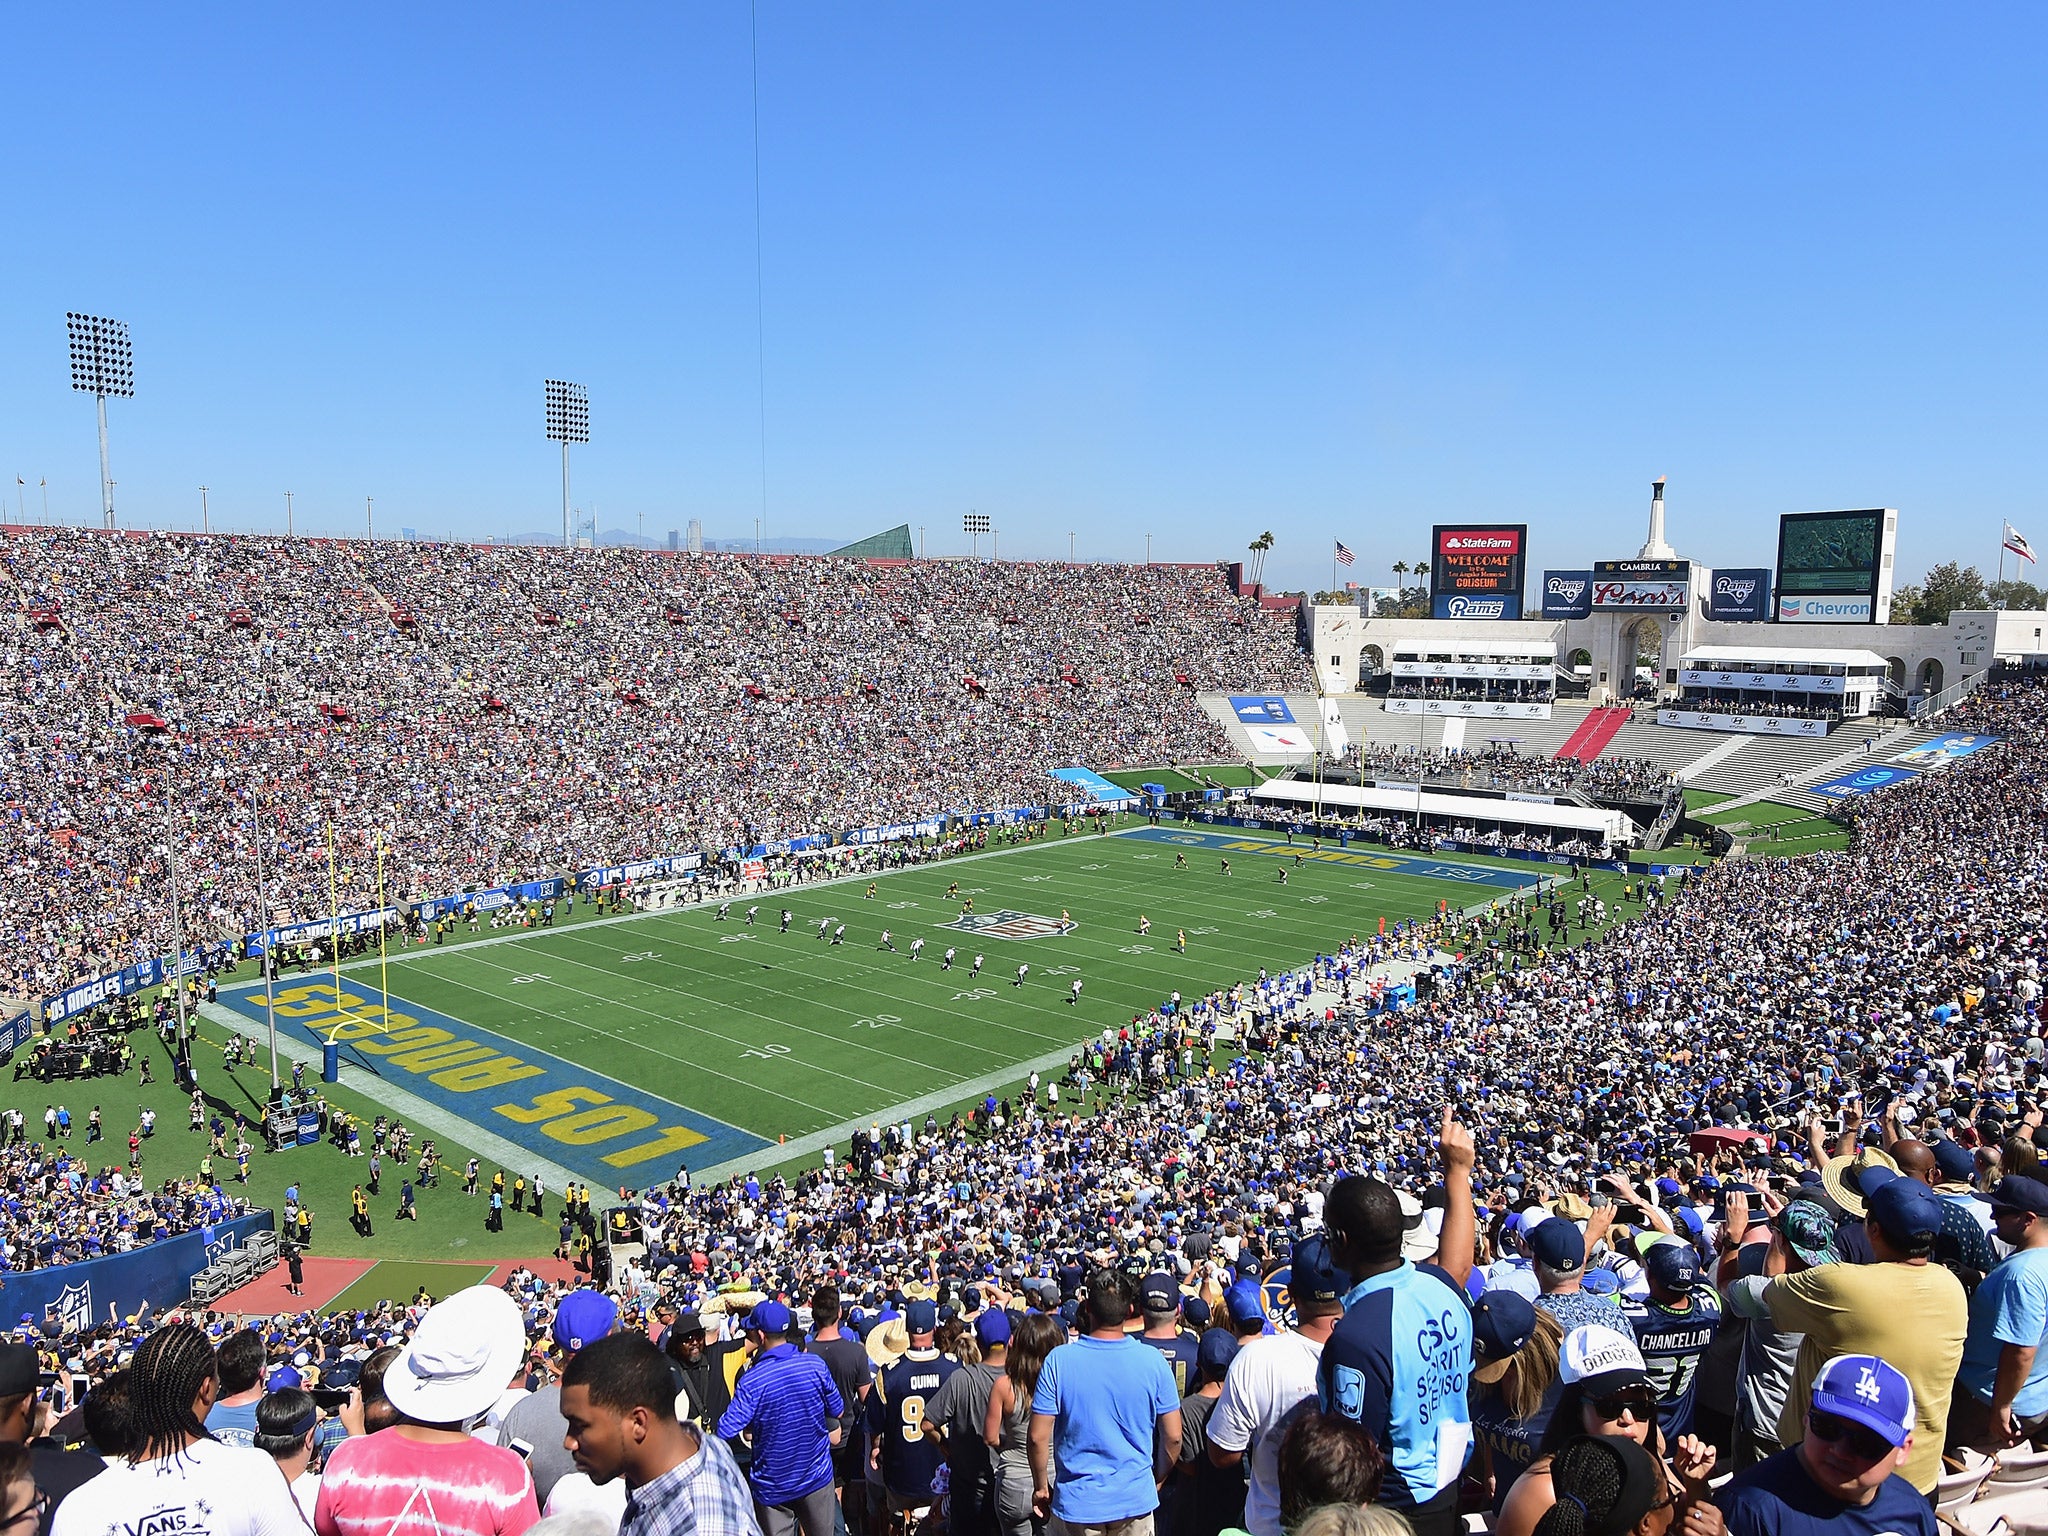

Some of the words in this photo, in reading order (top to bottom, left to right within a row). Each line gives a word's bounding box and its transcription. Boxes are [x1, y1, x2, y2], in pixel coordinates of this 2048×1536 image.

[1447, 556, 1510, 566] WELCOME
[1620, 563, 1661, 571] CAMBRIA
[1456, 578, 1497, 588] COLISEUM
[1548, 578, 1585, 594] Rams
[1594, 583, 1684, 604] Coors
[1448, 596, 1504, 619] Rams
[1806, 602, 1869, 615] Chevron
[862, 830, 877, 843] LOS
[1219, 841, 1410, 869] RAMS
[602, 870, 622, 884] LOS
[672, 856, 702, 872] RAMS
[473, 892, 505, 910] Rams
[274, 928, 298, 943] LOS
[512, 973, 551, 984] 10
[51, 1000, 64, 1020] OS
[68, 976, 120, 1014] ANGELES
[855, 1014, 901, 1028] 20
[245, 984, 548, 1092] ANGELES
[747, 1044, 792, 1059] 10
[492, 1086, 711, 1168] LOS
[1418, 1310, 1457, 1361] CSC
[1641, 1329, 1711, 1350] CHANCELLOR
[1583, 1348, 1642, 1372] DODGERS
[910, 1374, 940, 1390] QUINN
[1855, 1366, 1880, 1403] LA
[123, 1515, 186, 1536] VANS
